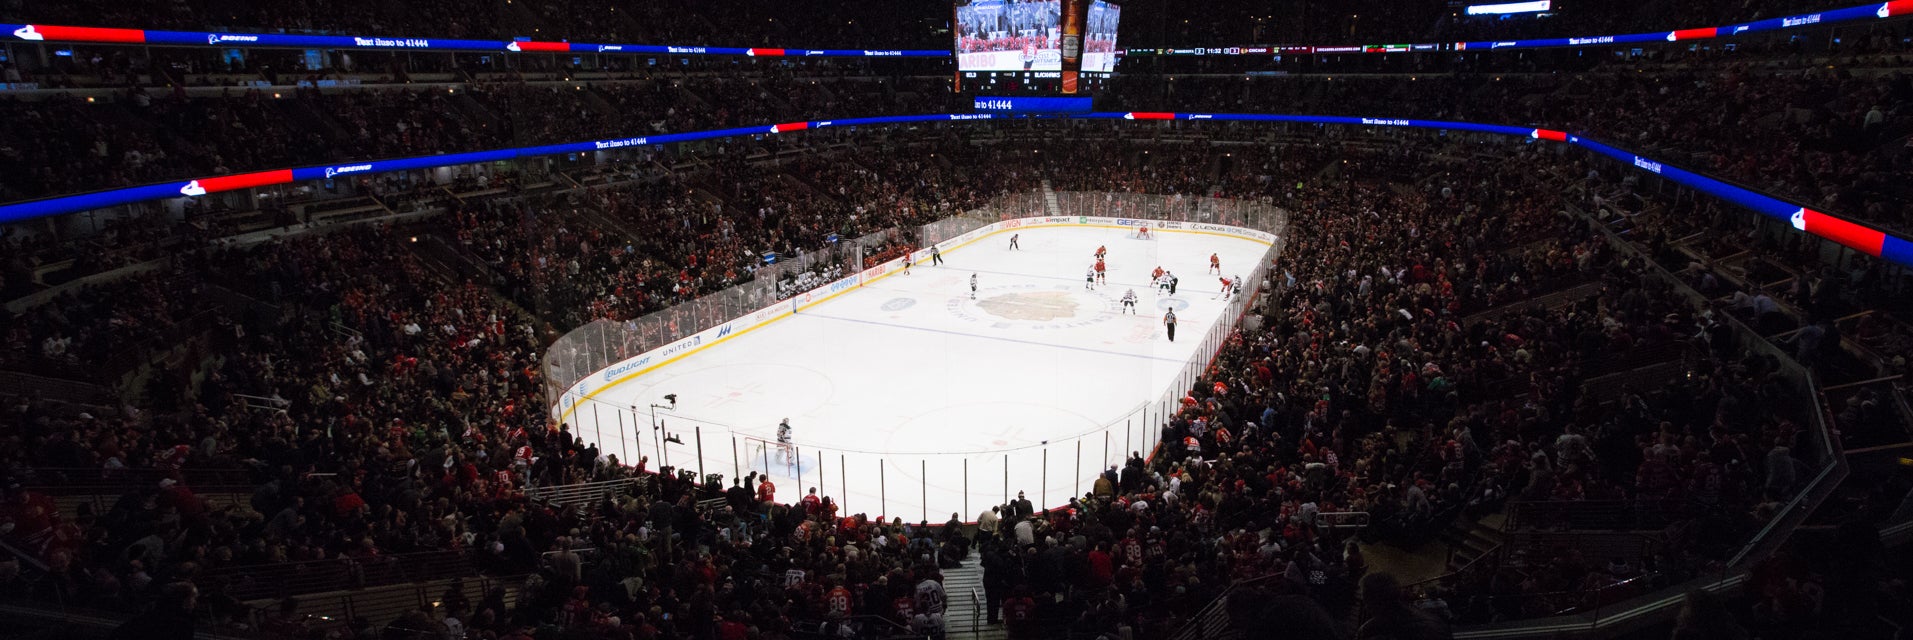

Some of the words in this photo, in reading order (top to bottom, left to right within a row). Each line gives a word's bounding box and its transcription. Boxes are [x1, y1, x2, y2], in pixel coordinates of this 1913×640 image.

[355, 37, 374, 46] Text
[396, 39, 404, 47] to
[405, 39, 428, 48] 41444
[987, 100, 1012, 109] 41444
[596, 141, 609, 149] Text
[630, 138, 647, 146] 41444
[337, 164, 372, 173] BOEING
[1005, 218, 1021, 228] WGN
[1117, 219, 1148, 227] GEICO
[662, 341, 692, 356] UNITED
[606, 365, 626, 378] BUD
[626, 356, 651, 371] LIGHT
